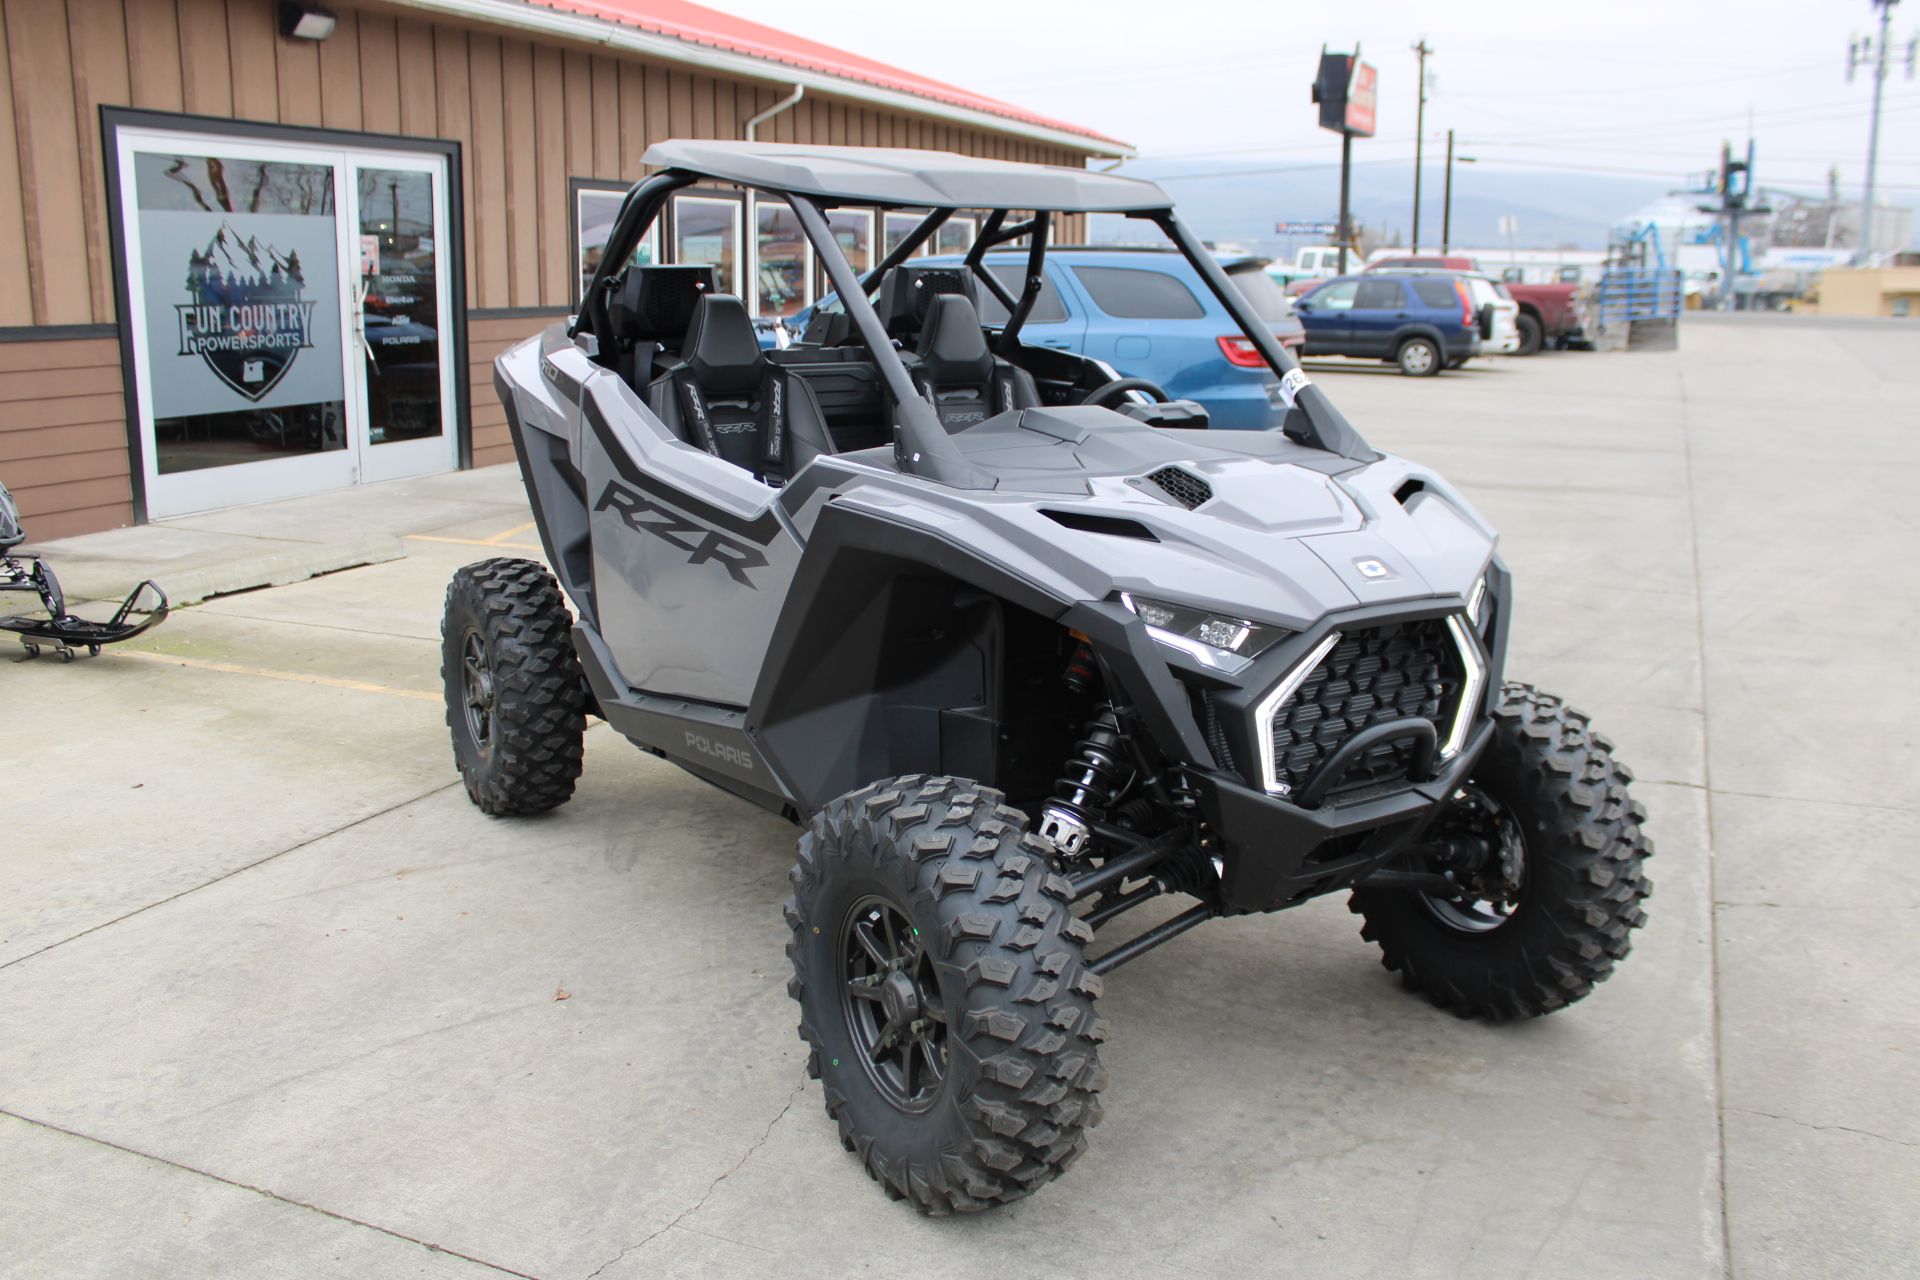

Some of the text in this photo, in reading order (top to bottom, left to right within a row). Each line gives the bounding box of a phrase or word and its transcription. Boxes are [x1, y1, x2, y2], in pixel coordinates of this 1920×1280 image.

[382, 274, 416, 283] HONDA
[175, 301, 318, 355] FUN COUNTRY
[198, 332, 301, 351] POWERSPORTS
[382, 336, 420, 345] POLARIS
[686, 383, 705, 420] RZR
[772, 379, 781, 416] RZR
[713, 422, 758, 434] RZR
[945, 411, 985, 423] RZR
[594, 479, 770, 591] RZR
[685, 731, 754, 770] POLARIS
